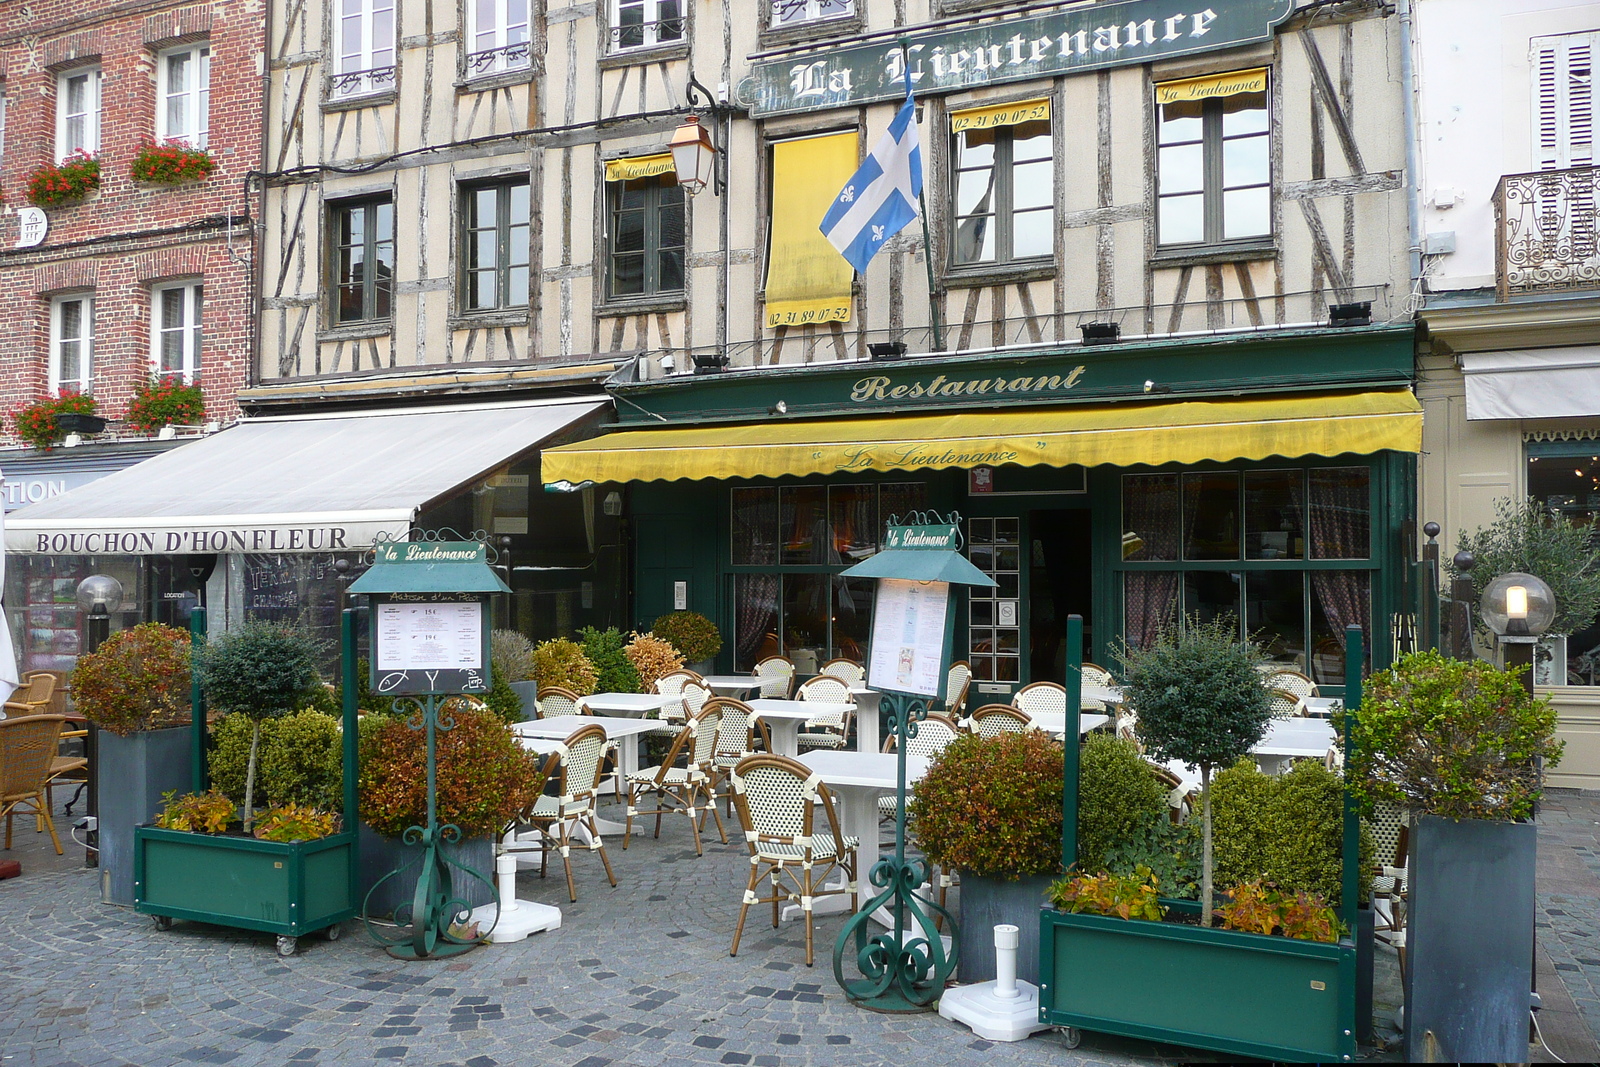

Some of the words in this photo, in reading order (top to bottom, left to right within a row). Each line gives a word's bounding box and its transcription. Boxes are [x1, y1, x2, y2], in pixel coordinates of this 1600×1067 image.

[790, 60, 853, 99] La
[885, 8, 1218, 85] Lieutenance
[1161, 86, 1178, 101] La
[1188, 80, 1261, 97] Lieutenance
[954, 117, 970, 130] 02
[973, 115, 988, 127] 31
[991, 112, 1007, 125] 89
[1011, 109, 1027, 122] 07
[1029, 106, 1045, 119] 52
[625, 162, 675, 178] Lieutenanc
[769, 313, 781, 326] 02
[784, 312, 797, 323] 31
[801, 310, 815, 322] 89
[818, 308, 831, 320] 07
[832, 307, 848, 319] 52
[850, 365, 1086, 402] Restaurant
[835, 445, 878, 469] La
[885, 443, 1018, 467] Lieutenance
[37, 532, 156, 553] BOUCHON
[165, 528, 348, 552] D'HONFLEUR
